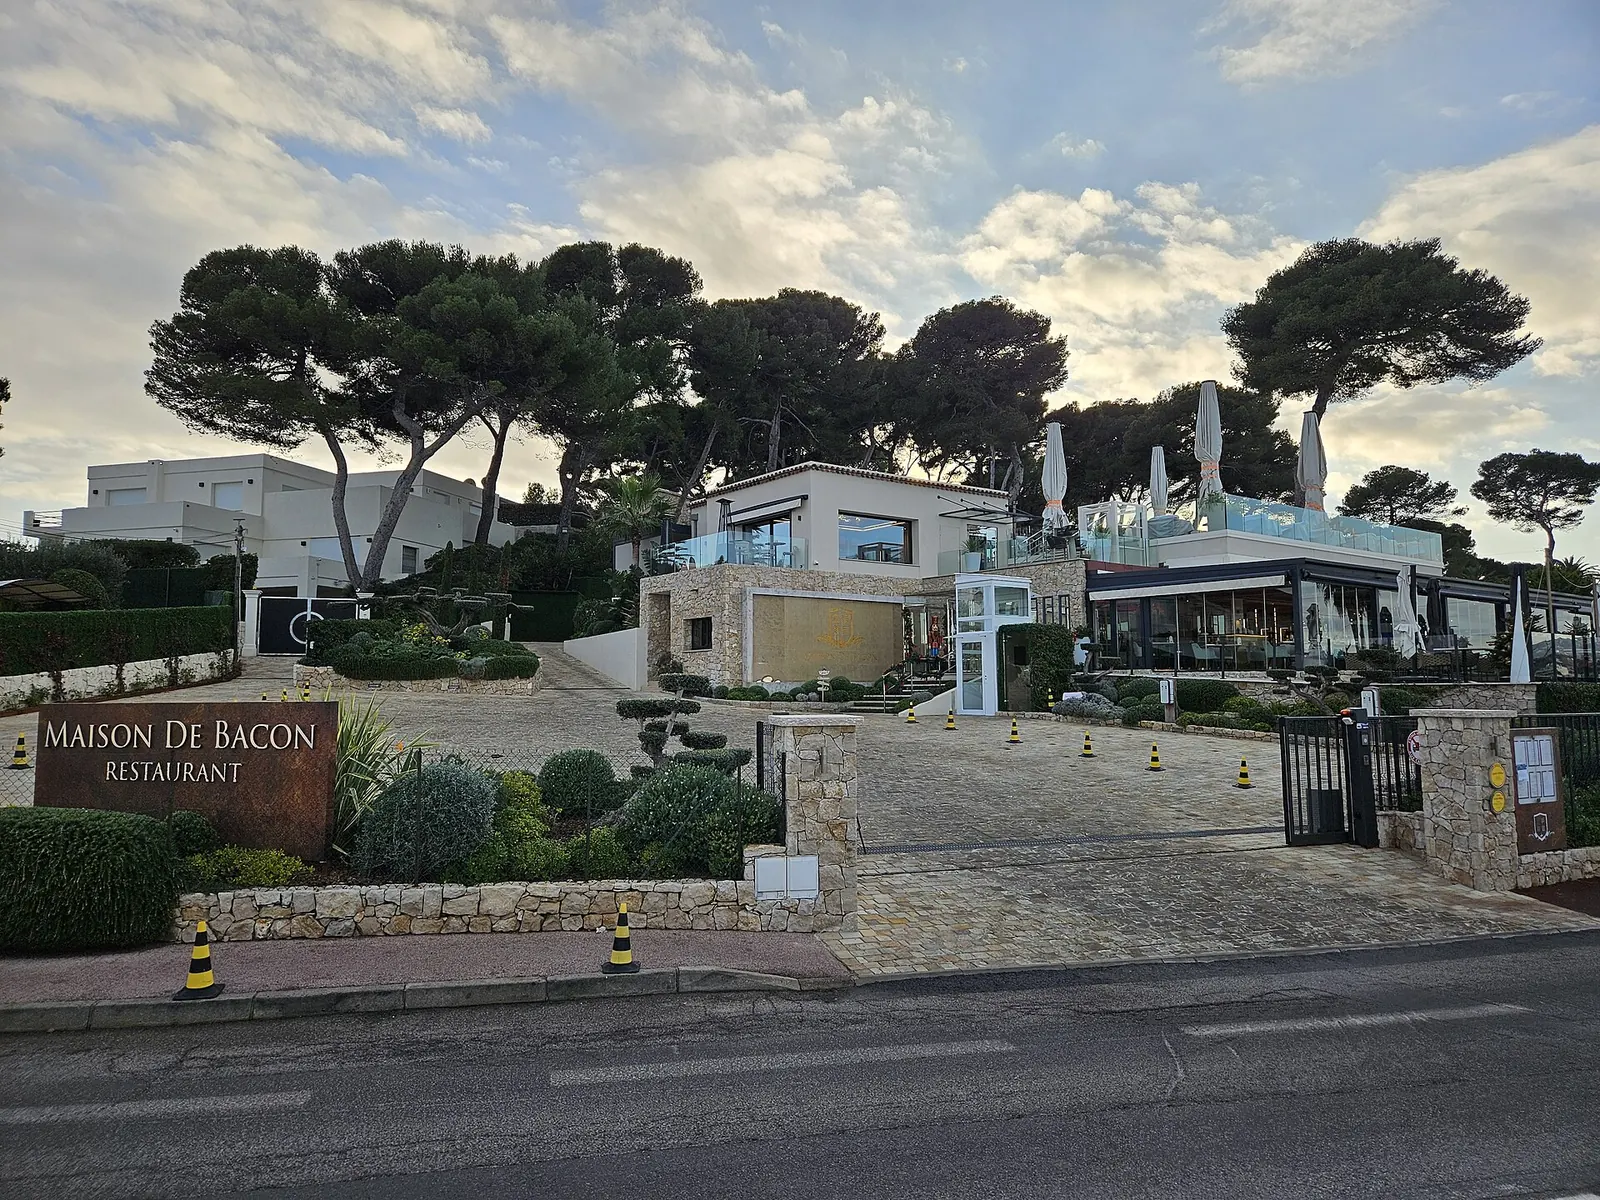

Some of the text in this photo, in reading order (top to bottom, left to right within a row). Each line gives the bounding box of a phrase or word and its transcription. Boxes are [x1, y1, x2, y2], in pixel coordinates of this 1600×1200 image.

[44, 720, 315, 750] MAISON DE BACON
[105, 761, 242, 783] RESTAURANT
